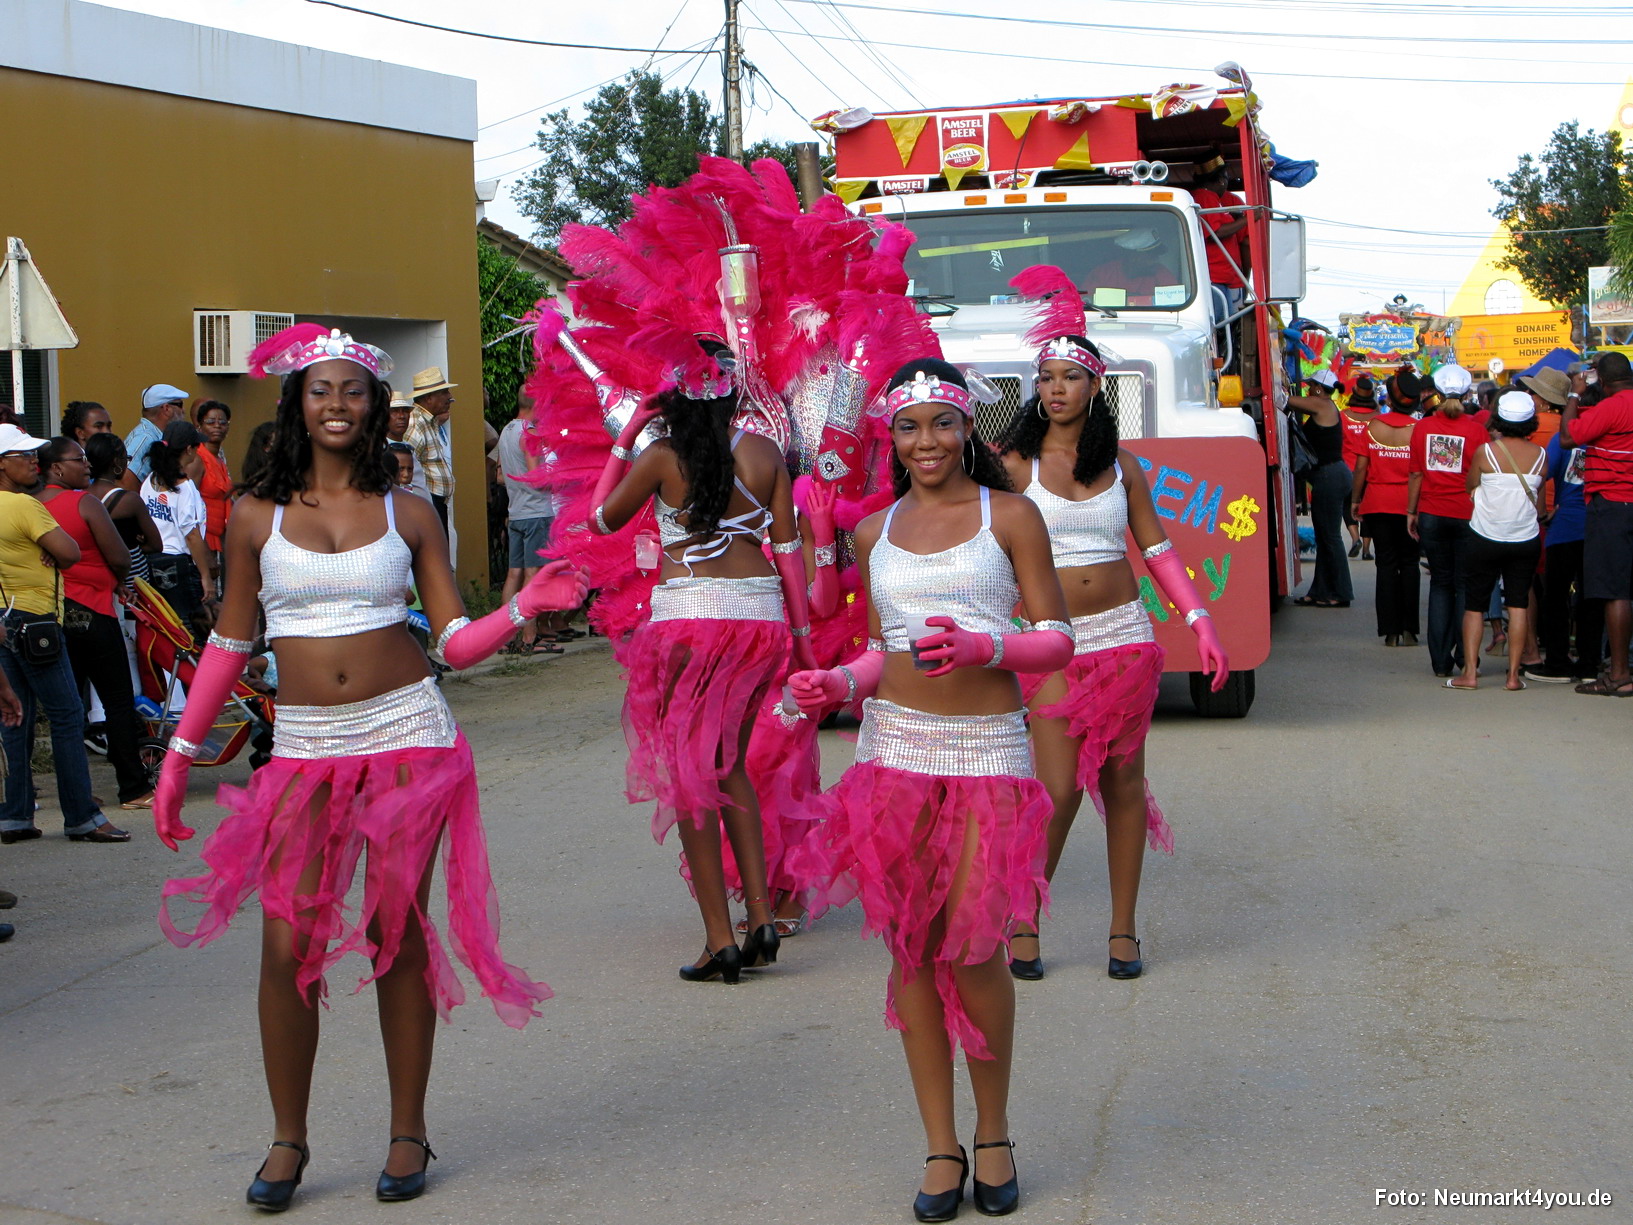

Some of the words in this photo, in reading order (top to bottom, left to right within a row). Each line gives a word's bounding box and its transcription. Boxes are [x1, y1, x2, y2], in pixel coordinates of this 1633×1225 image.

[942, 118, 983, 130] AMSTEL
[950, 128, 976, 138] BEER
[946, 149, 977, 159] AMSTEL
[954, 156, 972, 164] BEER
[1110, 167, 1133, 176] AMS
[884, 180, 923, 191] AMSTEL
[1516, 324, 1557, 333] BONAIRE
[1378, 340, 1386, 348] of
[1513, 336, 1560, 345] SUNSHINE
[1519, 348, 1552, 357] HOMES
[1137, 456, 1261, 542] EM$
